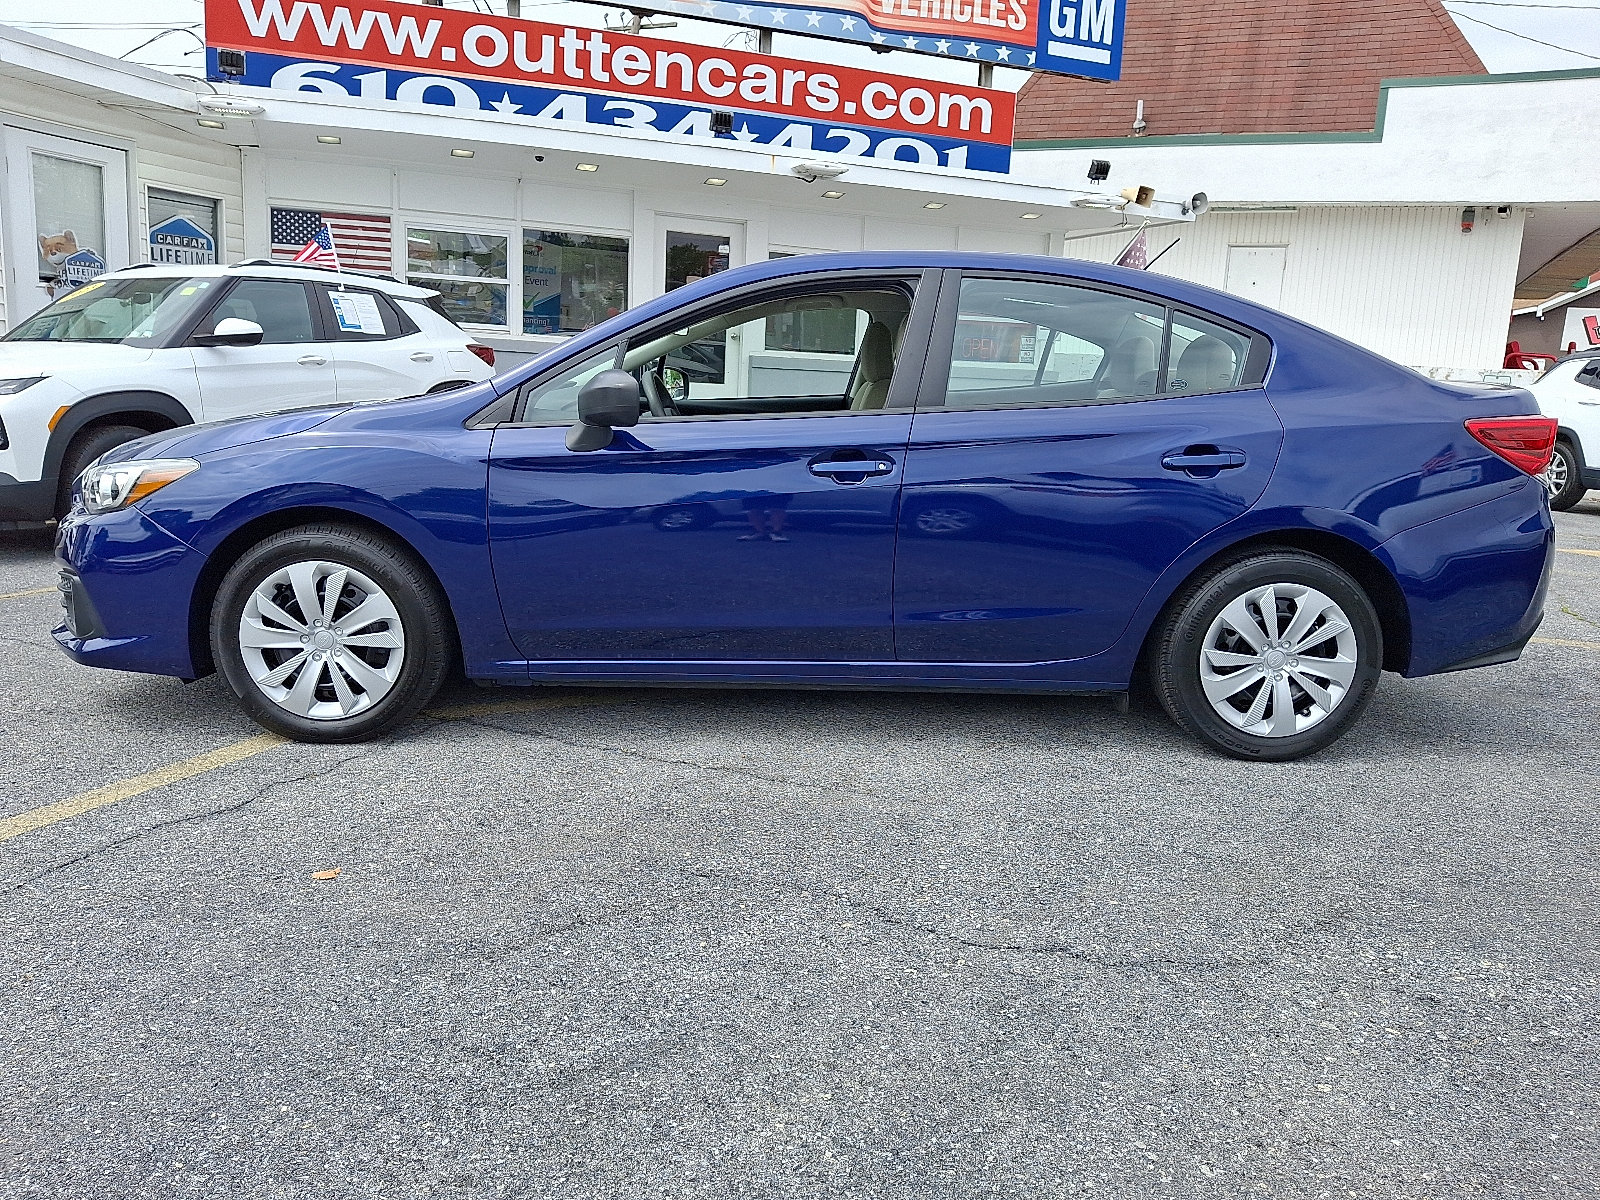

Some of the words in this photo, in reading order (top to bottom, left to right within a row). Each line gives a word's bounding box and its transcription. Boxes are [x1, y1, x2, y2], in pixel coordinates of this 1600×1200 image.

[1049, 0, 1115, 46] GM
[236, 0, 993, 134] www.outtencars.com
[156, 233, 207, 250] CARFAX
[523, 264, 557, 275] pproval
[525, 275, 549, 287] Event
[962, 337, 999, 359] OPEN
